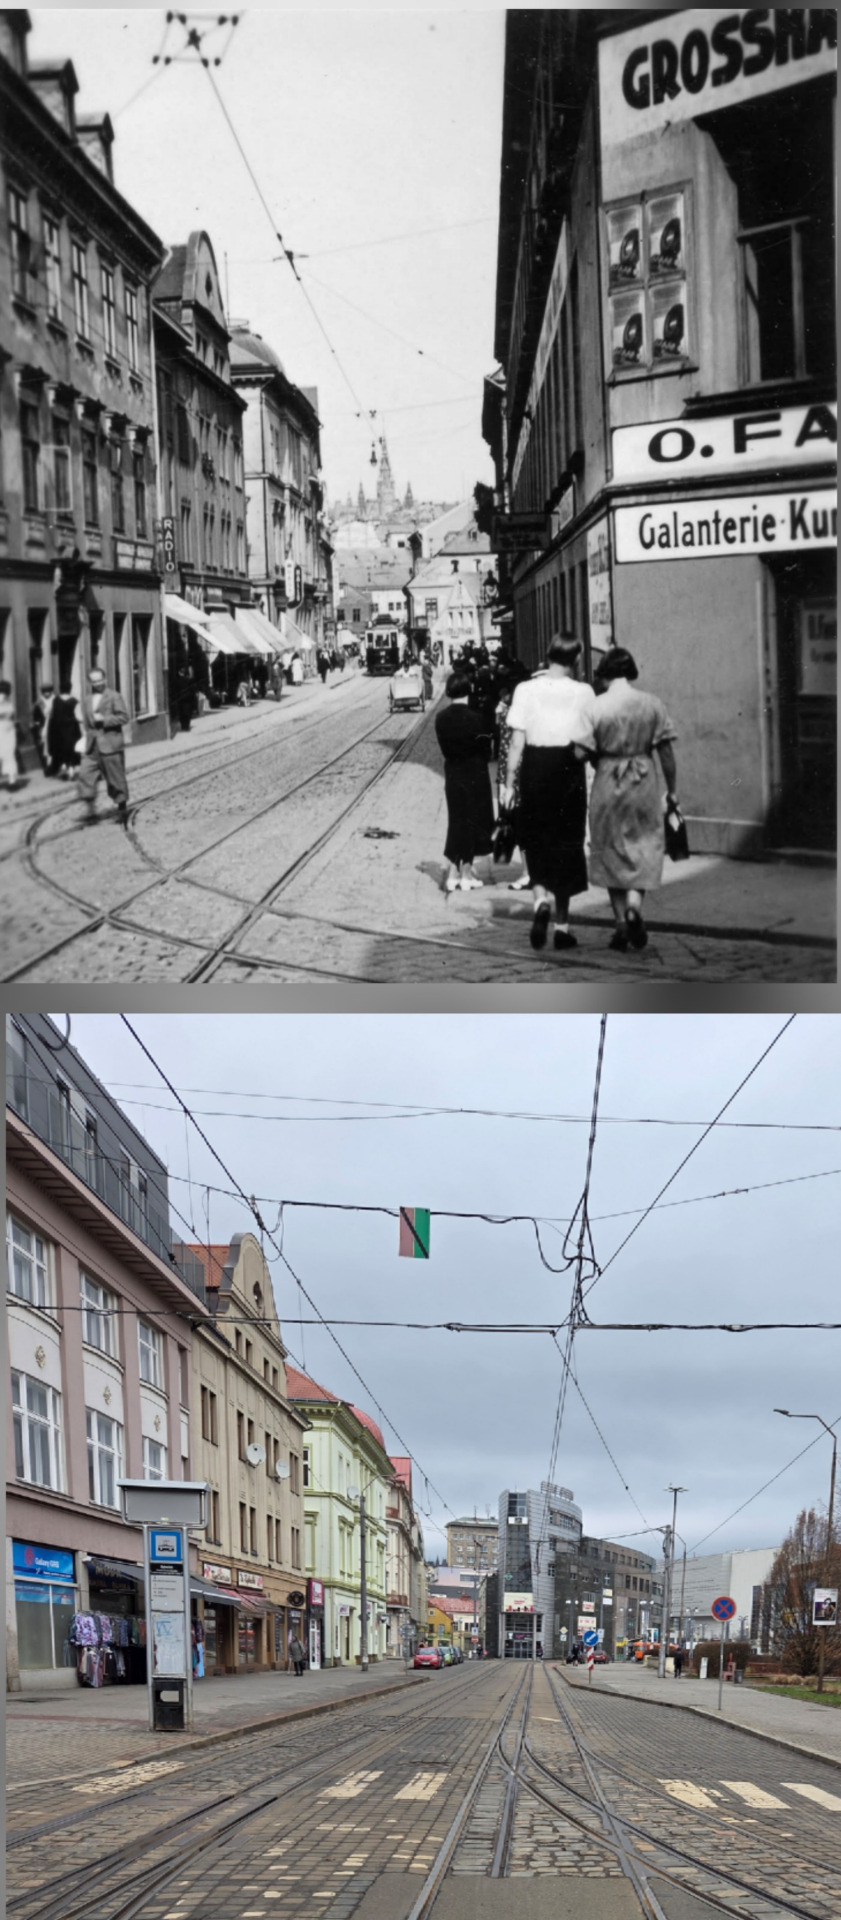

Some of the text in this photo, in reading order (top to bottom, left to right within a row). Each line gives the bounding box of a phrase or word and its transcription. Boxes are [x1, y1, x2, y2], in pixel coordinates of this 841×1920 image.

[648, 404, 837, 463] O. FA
[163, 518, 175, 572] RADIO
[639, 504, 776, 550] Galanterie
